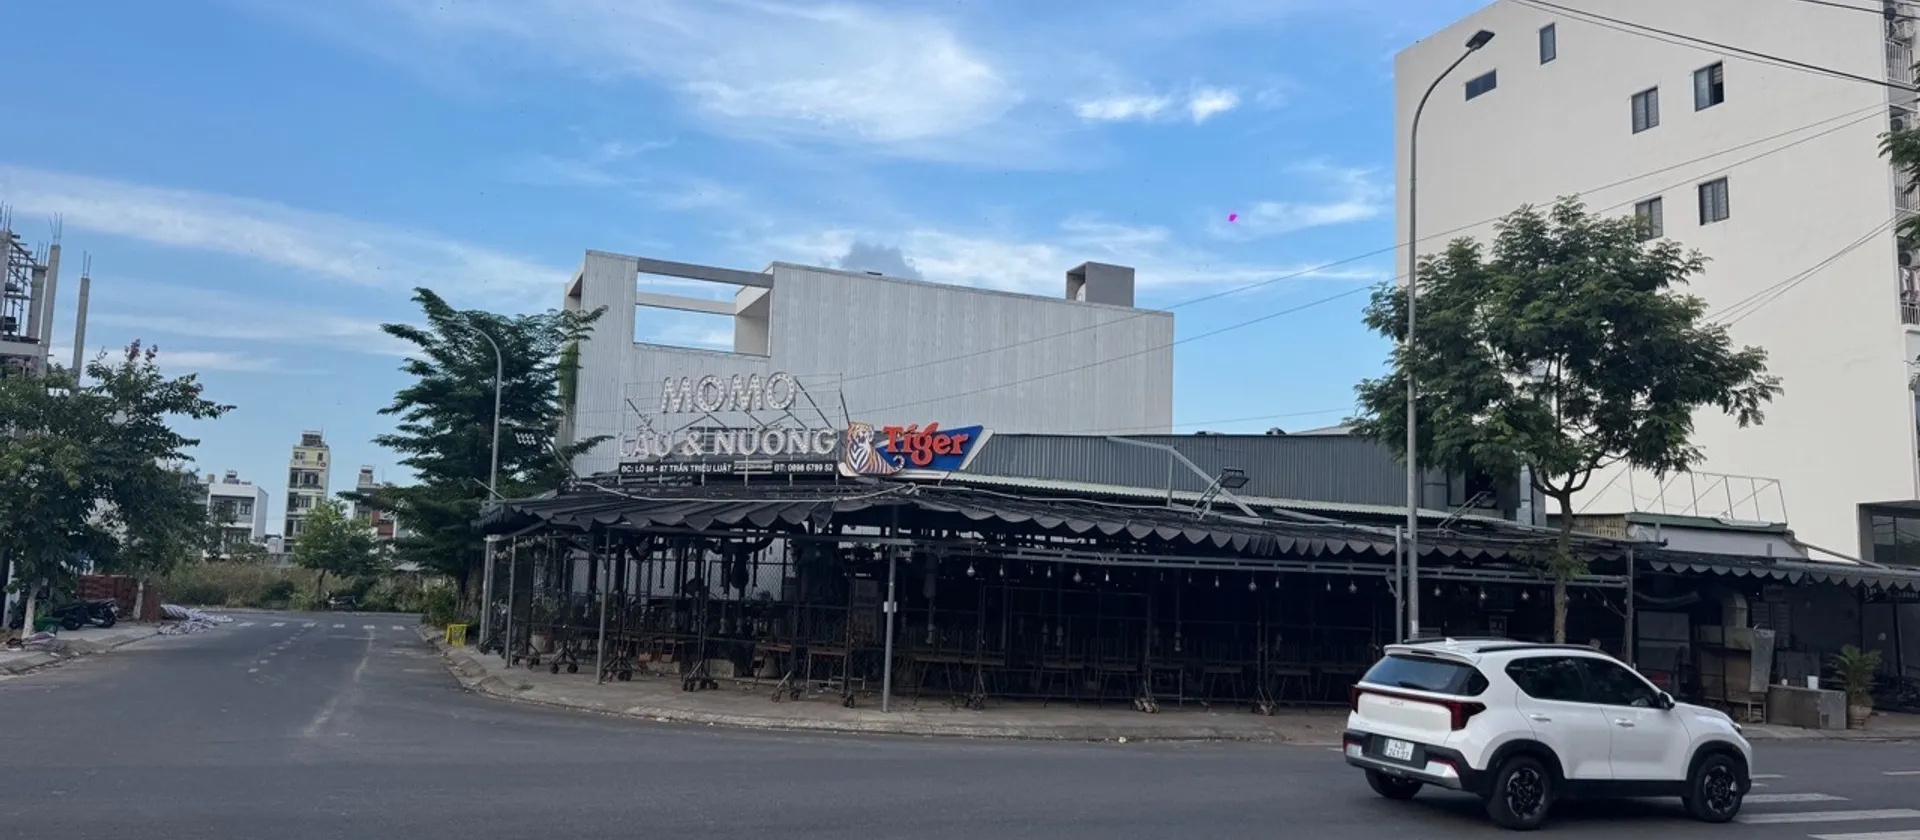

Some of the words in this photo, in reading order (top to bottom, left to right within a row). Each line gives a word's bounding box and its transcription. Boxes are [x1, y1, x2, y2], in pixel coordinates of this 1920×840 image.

[660, 371, 797, 413] MOMO
[682, 431, 704, 456] &
[882, 421, 969, 466] Tiger
